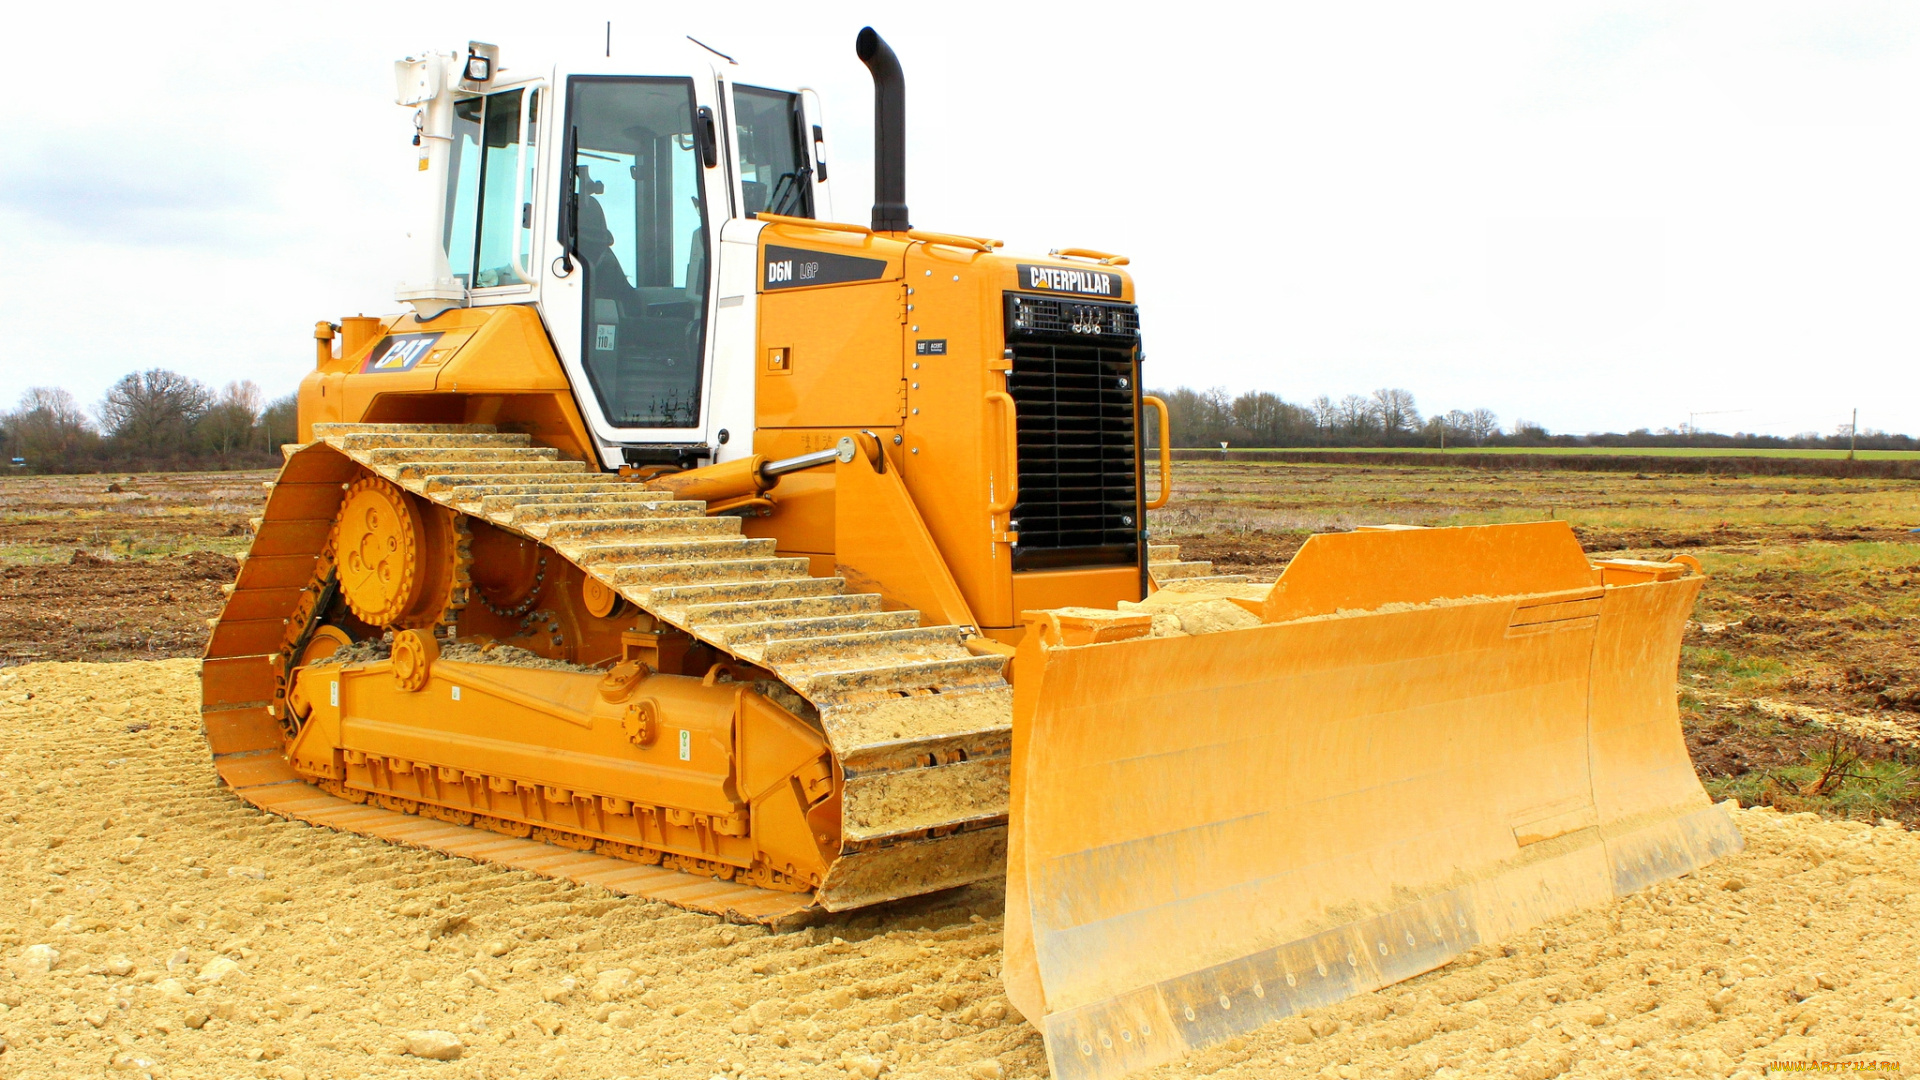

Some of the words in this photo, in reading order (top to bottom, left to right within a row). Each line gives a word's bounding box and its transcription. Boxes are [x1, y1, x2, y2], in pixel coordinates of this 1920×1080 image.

[768, 260, 793, 283] D6N
[799, 262, 819, 280] LGP
[1030, 266, 1111, 295] CATERPILLAR
[374, 339, 435, 369] CAT
